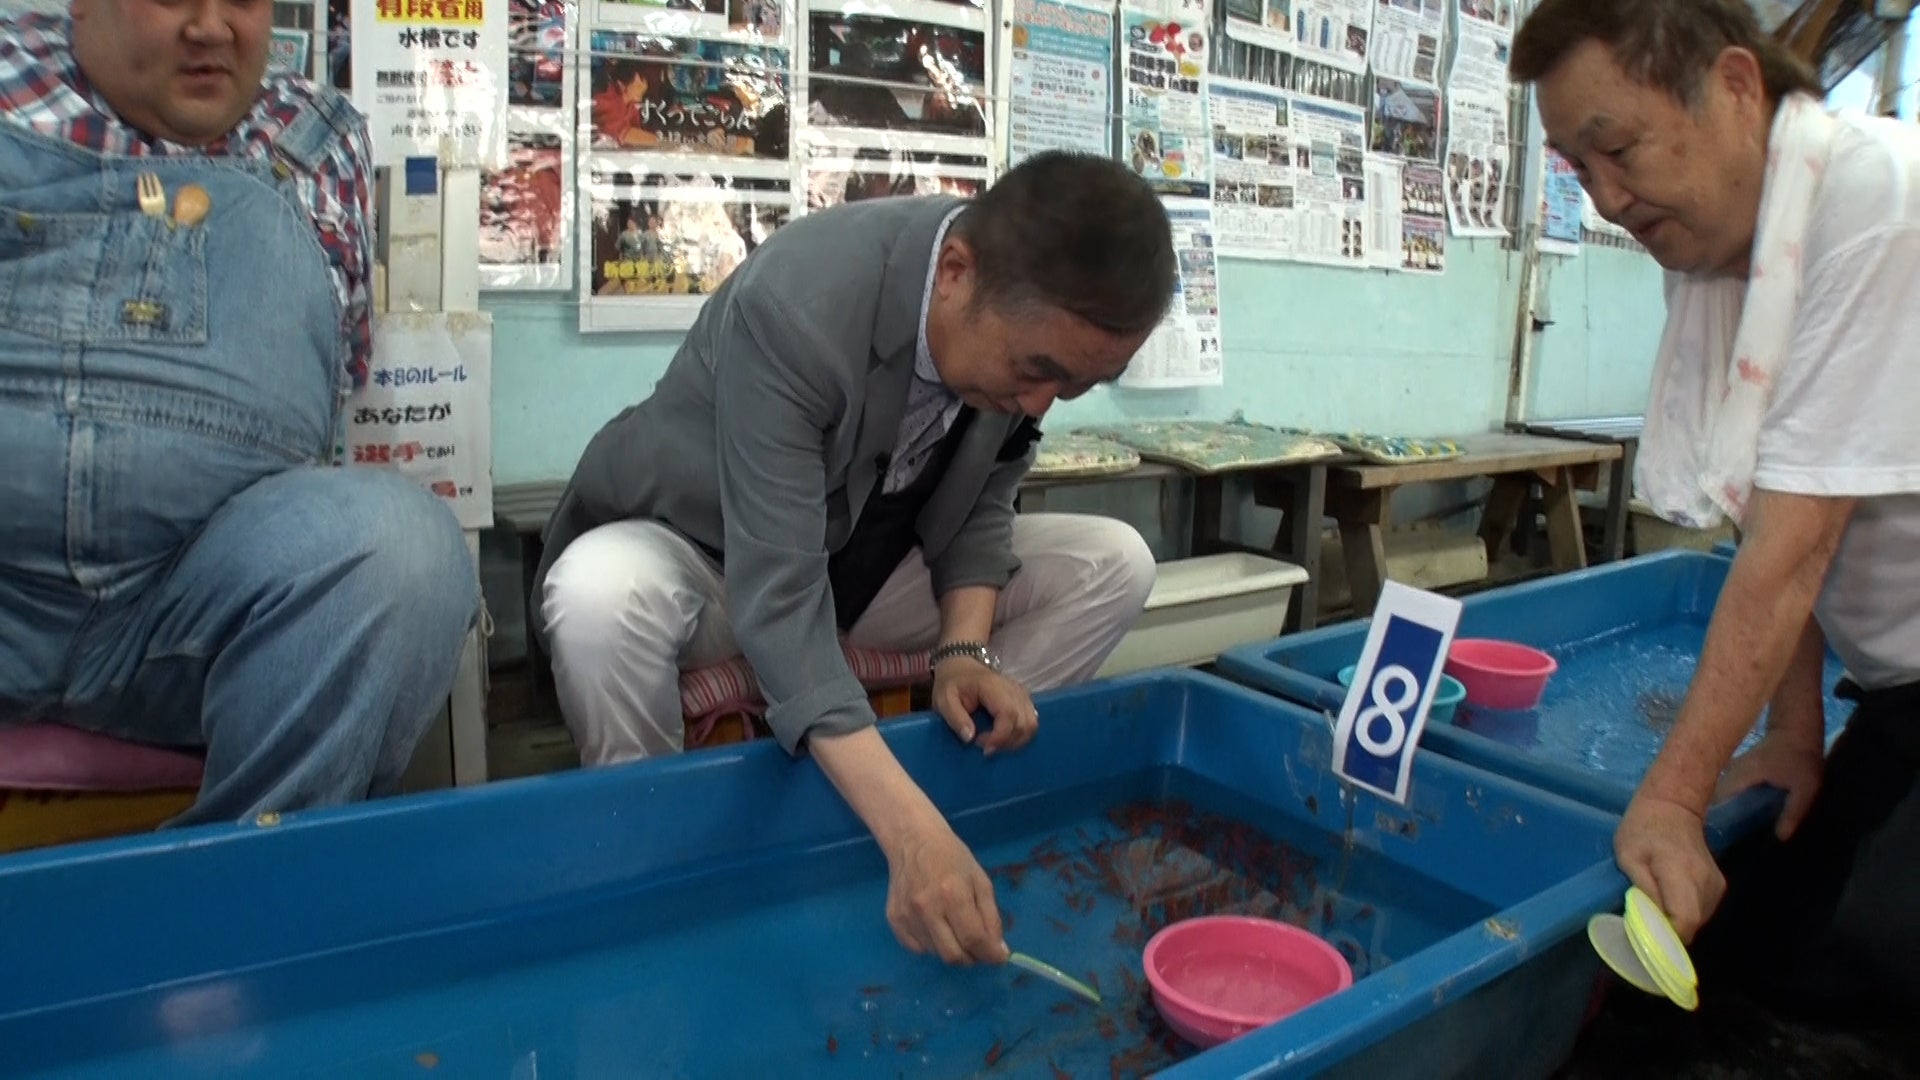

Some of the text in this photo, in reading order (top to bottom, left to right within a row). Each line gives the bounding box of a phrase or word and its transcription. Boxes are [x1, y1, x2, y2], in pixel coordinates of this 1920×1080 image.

[376, 0, 483, 19] 有段者用
[398, 27, 481, 49] 水槽です
[641, 99, 758, 132] すくってごらん
[374, 365, 468, 388] 本日のルール
[354, 402, 452, 426] あなたが
[1355, 664, 1419, 757] 8
